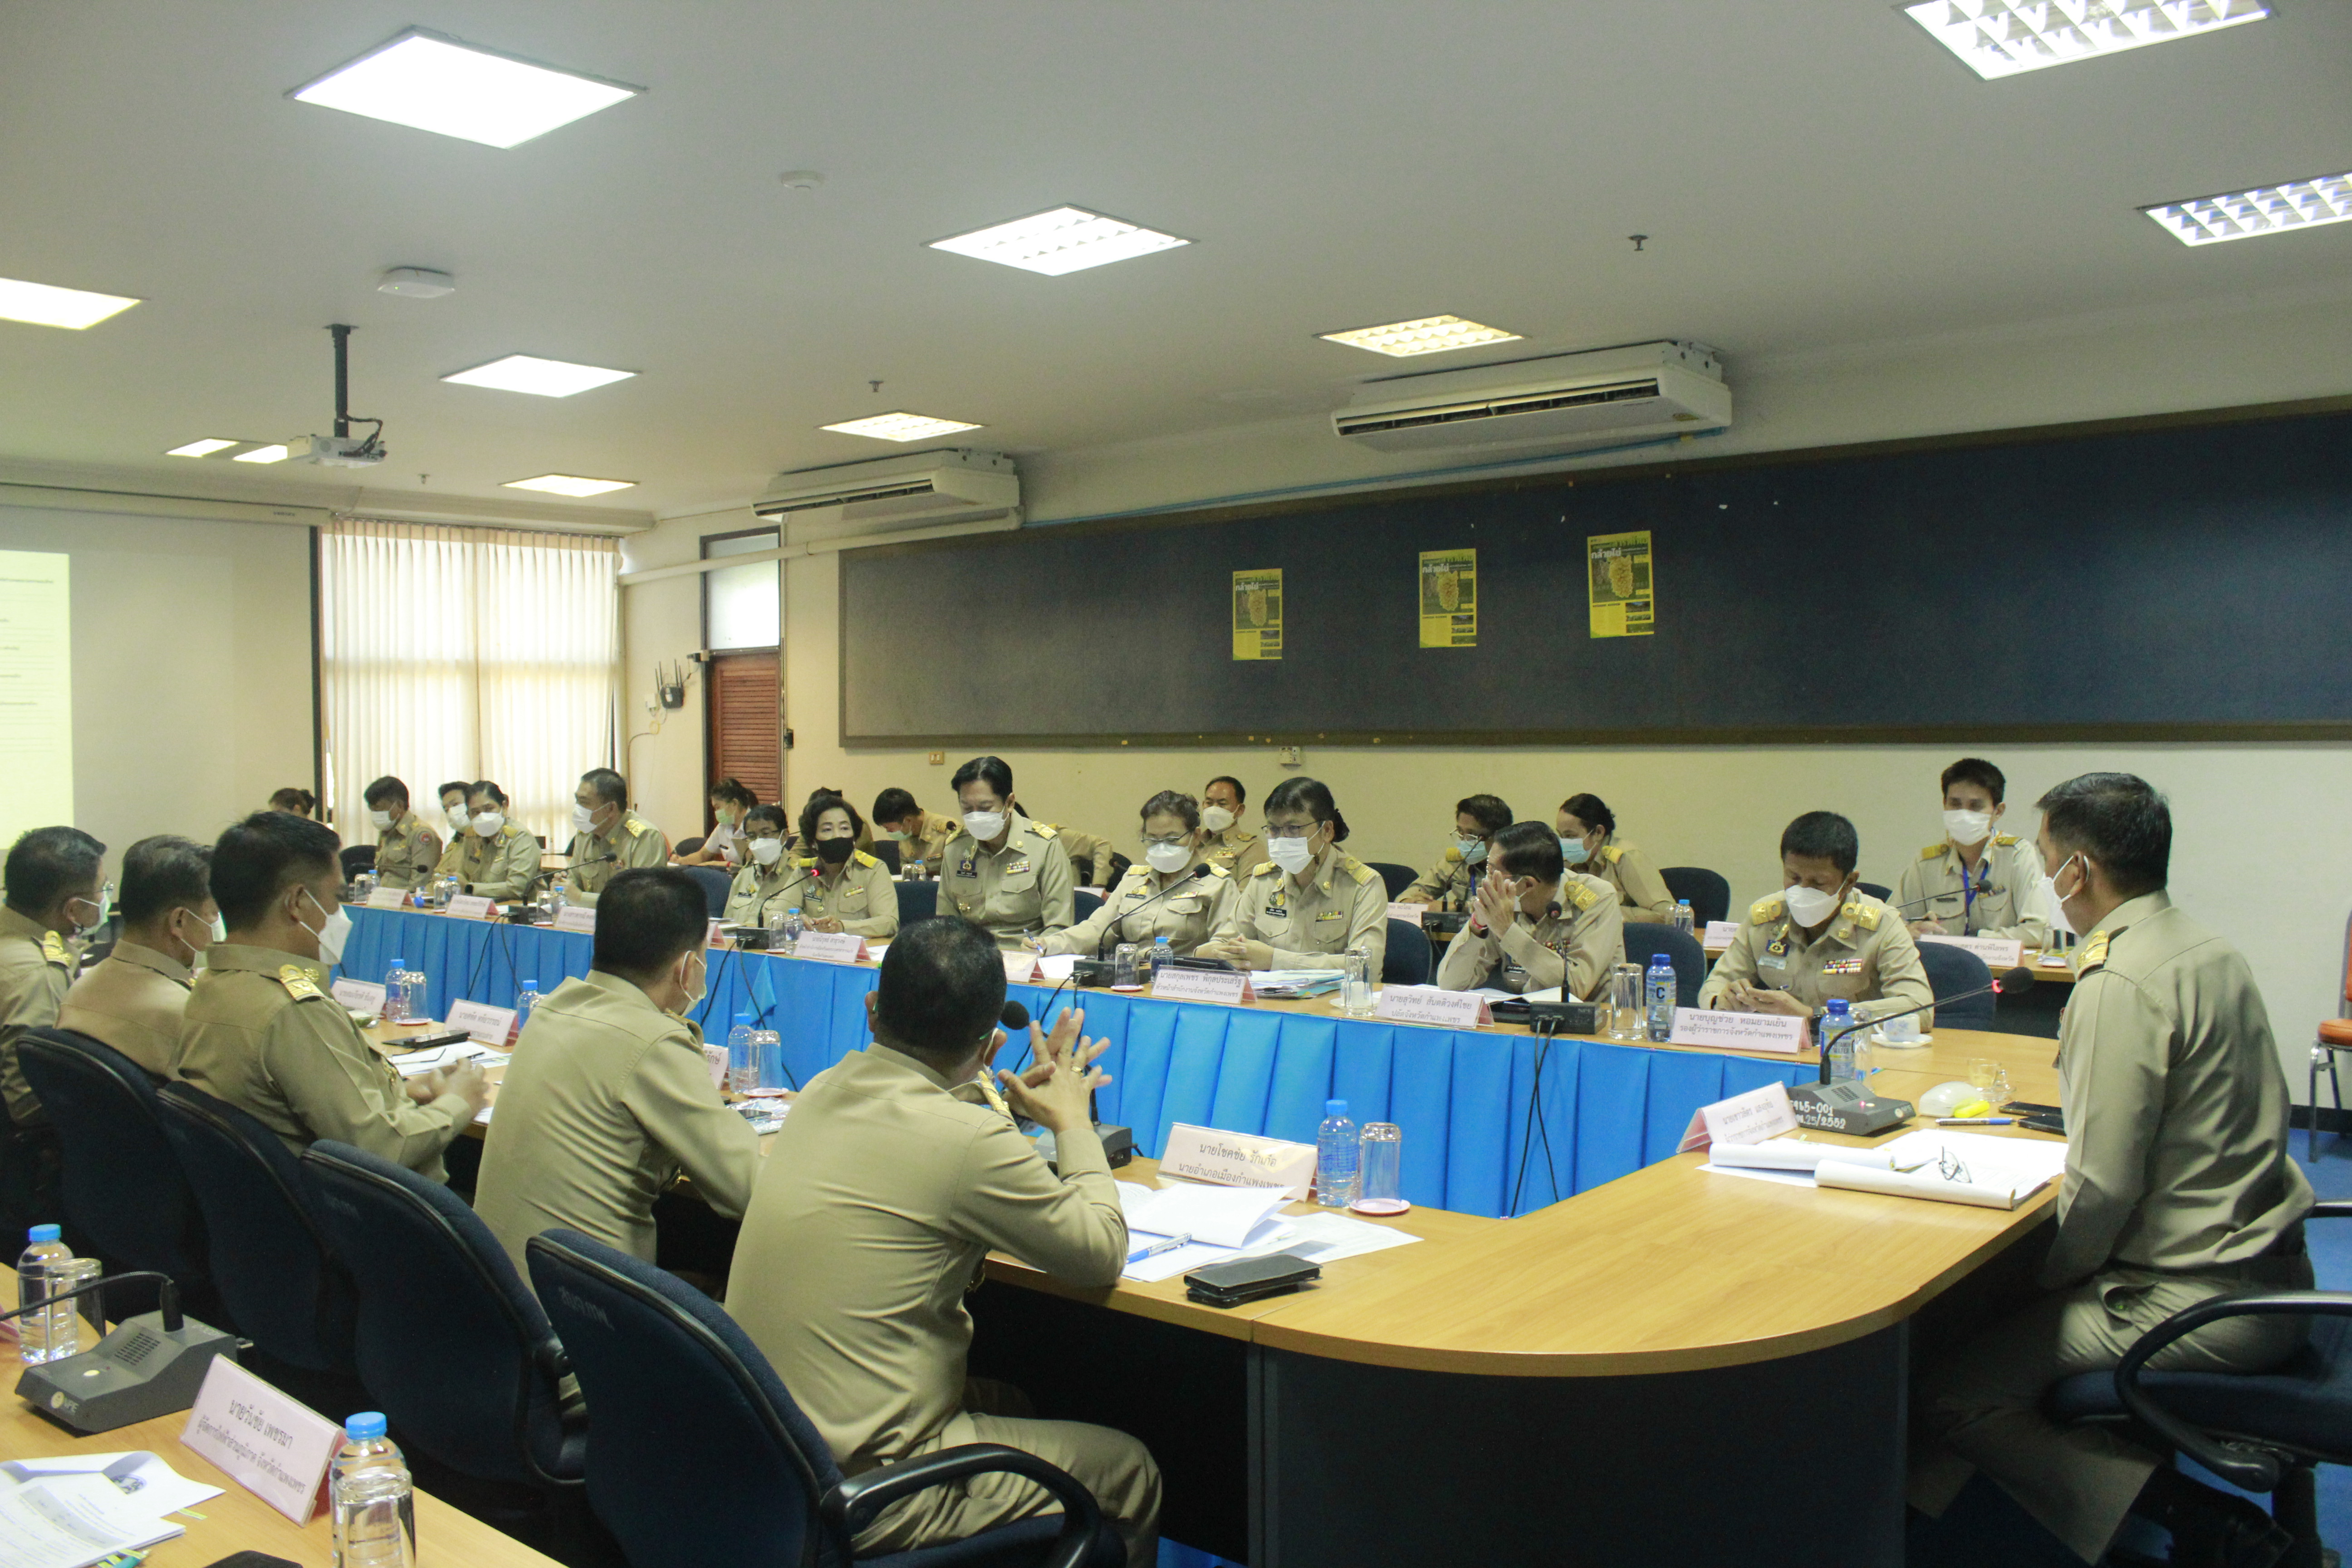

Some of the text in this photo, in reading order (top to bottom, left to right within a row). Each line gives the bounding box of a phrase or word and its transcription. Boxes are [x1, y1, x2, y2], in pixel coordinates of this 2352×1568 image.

[1656, 987, 1665, 999] C
[1689, 1013, 1734, 1026] นายบุญช่วย
[1200, 1143, 1246, 1161] นายโชคชัย
